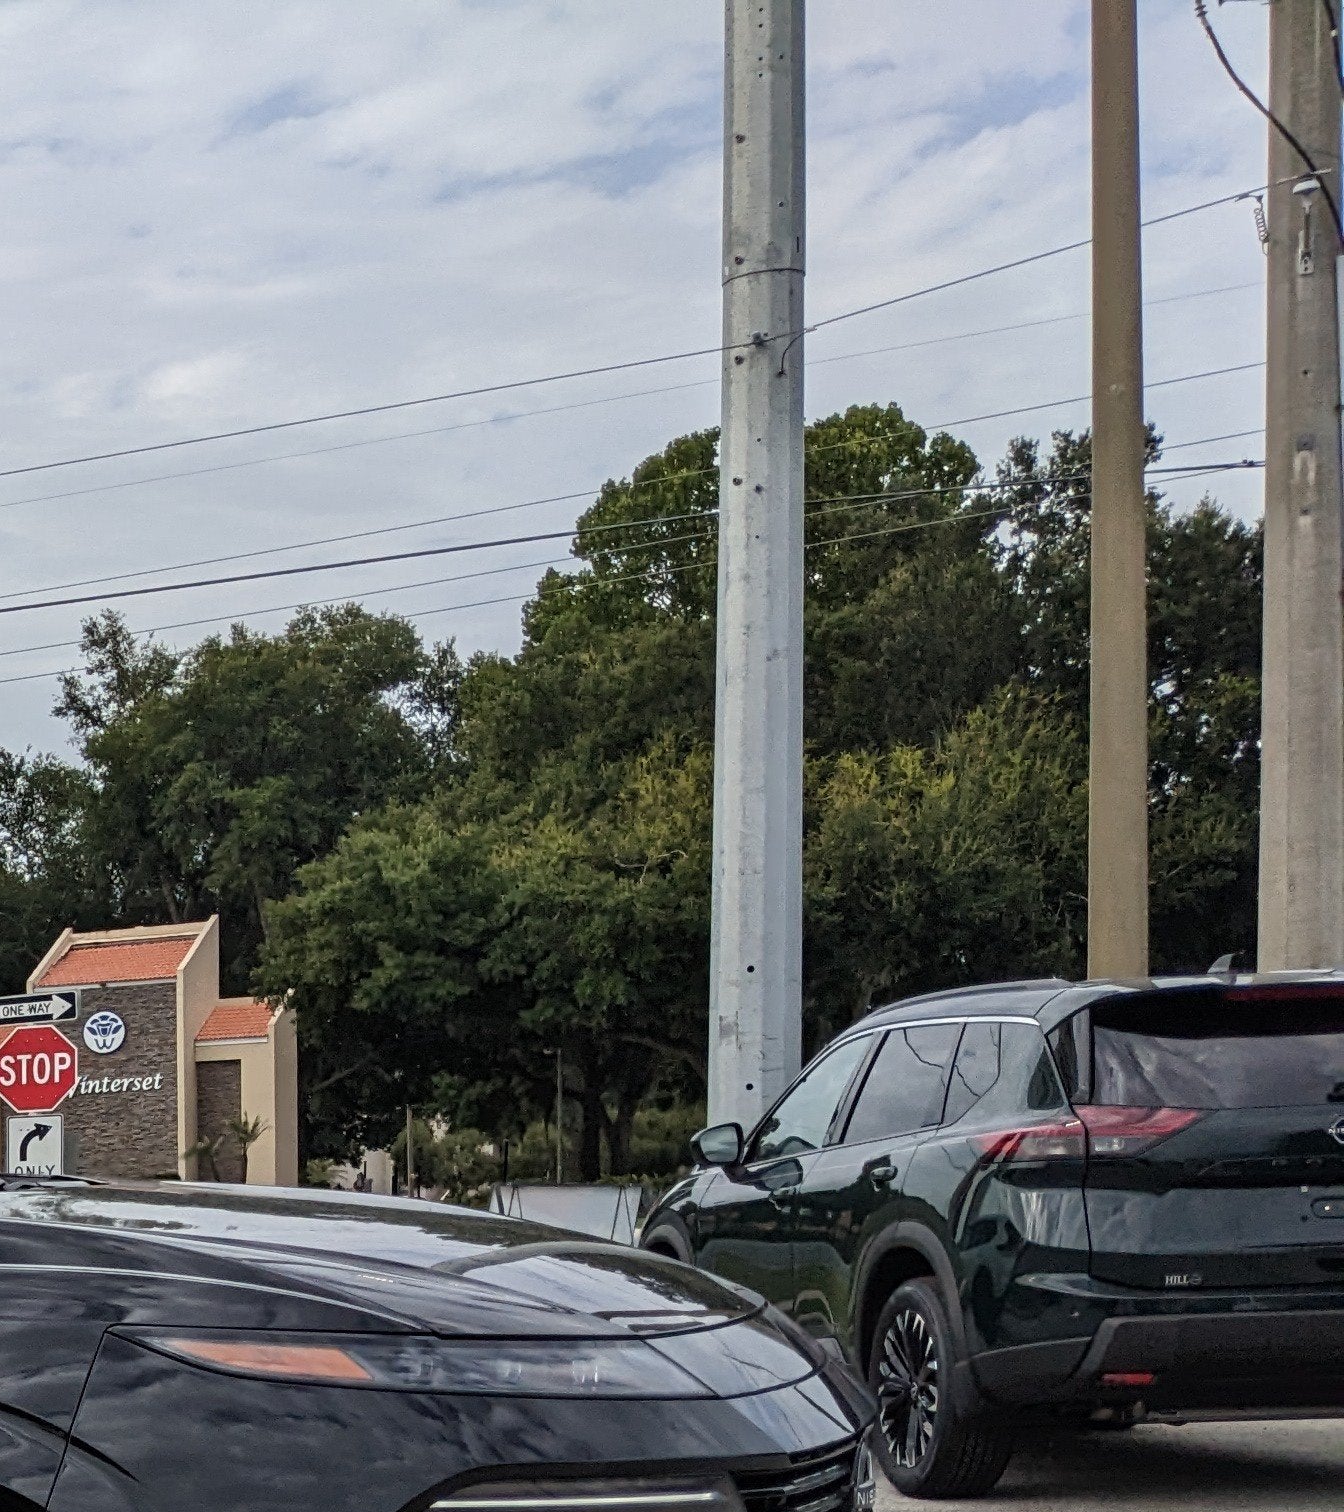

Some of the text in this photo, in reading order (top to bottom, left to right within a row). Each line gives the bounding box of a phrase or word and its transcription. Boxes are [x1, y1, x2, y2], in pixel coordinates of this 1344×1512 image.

[2, 1004, 52, 1018] ONE WAY
[0, 1052, 72, 1087] STOP
[69, 1073, 164, 1098] interset
[1165, 1275, 1189, 1286] HILL
